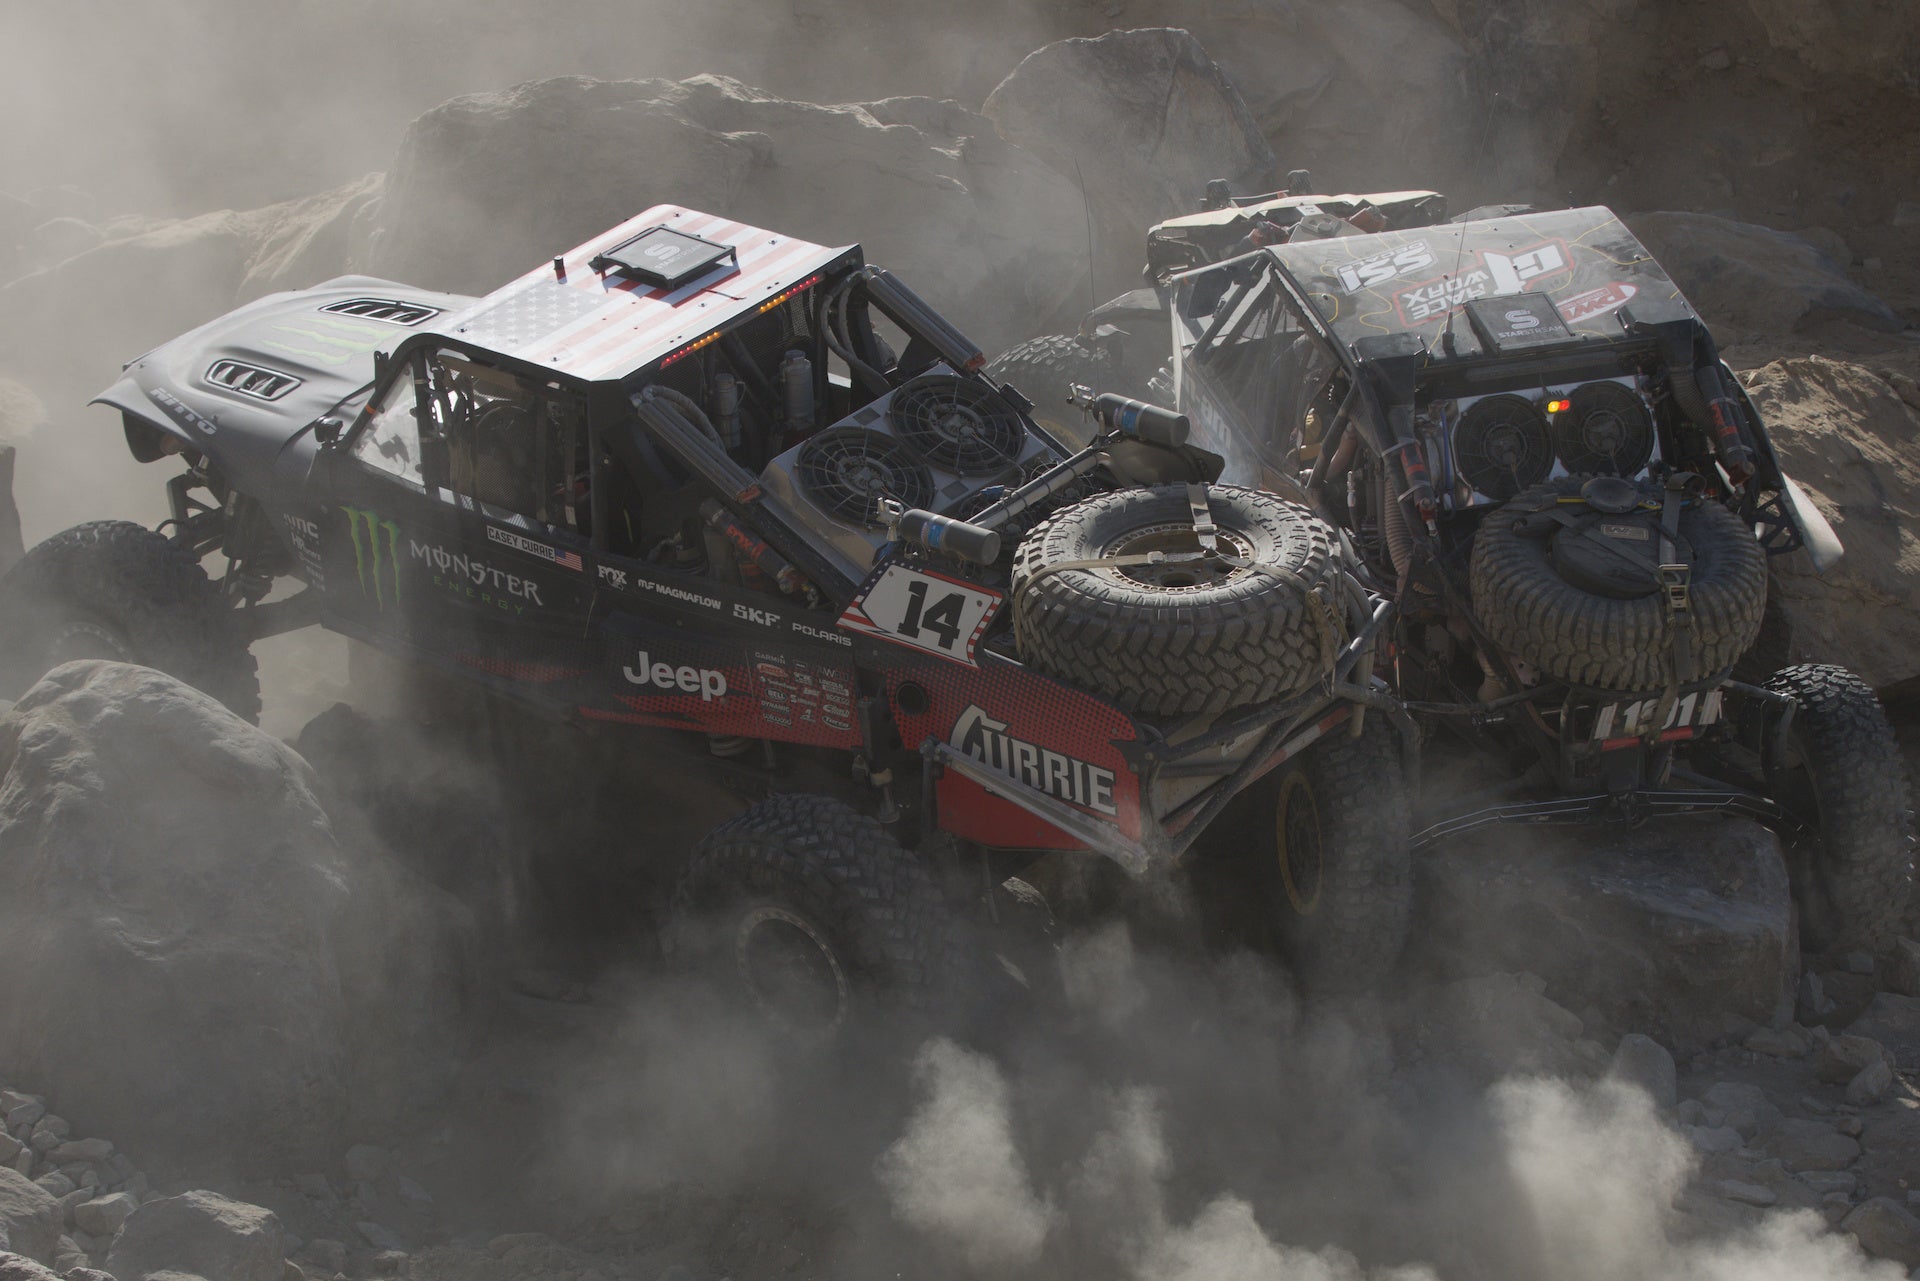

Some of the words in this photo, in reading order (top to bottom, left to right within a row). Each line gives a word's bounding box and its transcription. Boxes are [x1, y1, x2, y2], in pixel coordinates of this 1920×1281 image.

[1411, 283, 1487, 320] RACE
[1497, 324, 1565, 339] STARSTREAM
[149, 387, 218, 436] NITTO
[488, 528, 519, 550] CASEY
[521, 539, 555, 560] CURRIE
[597, 564, 628, 591] FOX
[433, 575, 525, 616] ENERGY
[655, 583, 722, 611] MAGNAFLOW
[733, 603, 782, 629] SKF
[896, 580, 967, 651] 14
[792, 622, 853, 647] POLARIS
[754, 651, 786, 665] GARMIN
[622, 650, 728, 702] Jeep
[949, 703, 1119, 816] CURRIE
